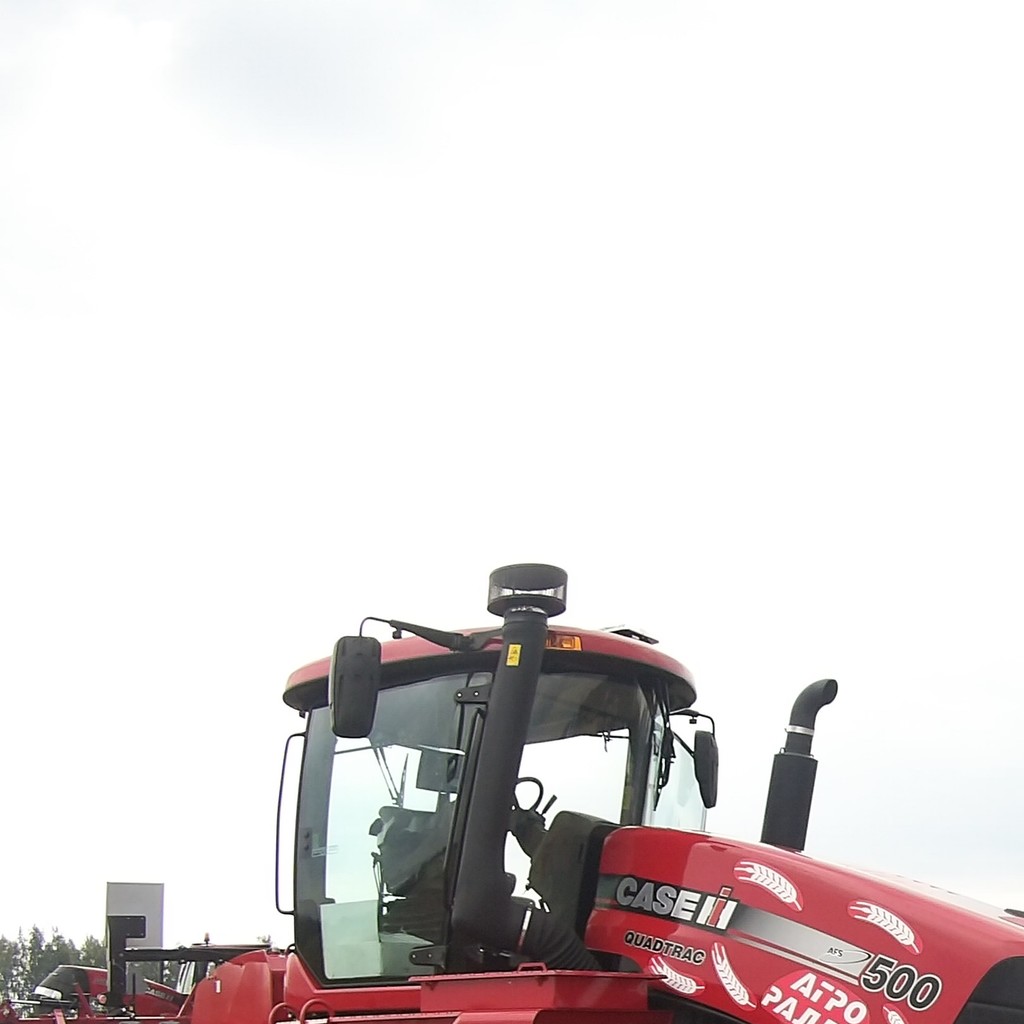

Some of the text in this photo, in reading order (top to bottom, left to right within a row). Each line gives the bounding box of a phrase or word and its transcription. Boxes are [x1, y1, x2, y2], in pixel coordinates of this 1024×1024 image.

[616, 877, 701, 921] CASE
[624, 931, 706, 964] QUADTRAC
[827, 947, 843, 957] AFS
[790, 972, 868, 1024] АГРО
[861, 955, 942, 1011] 500
